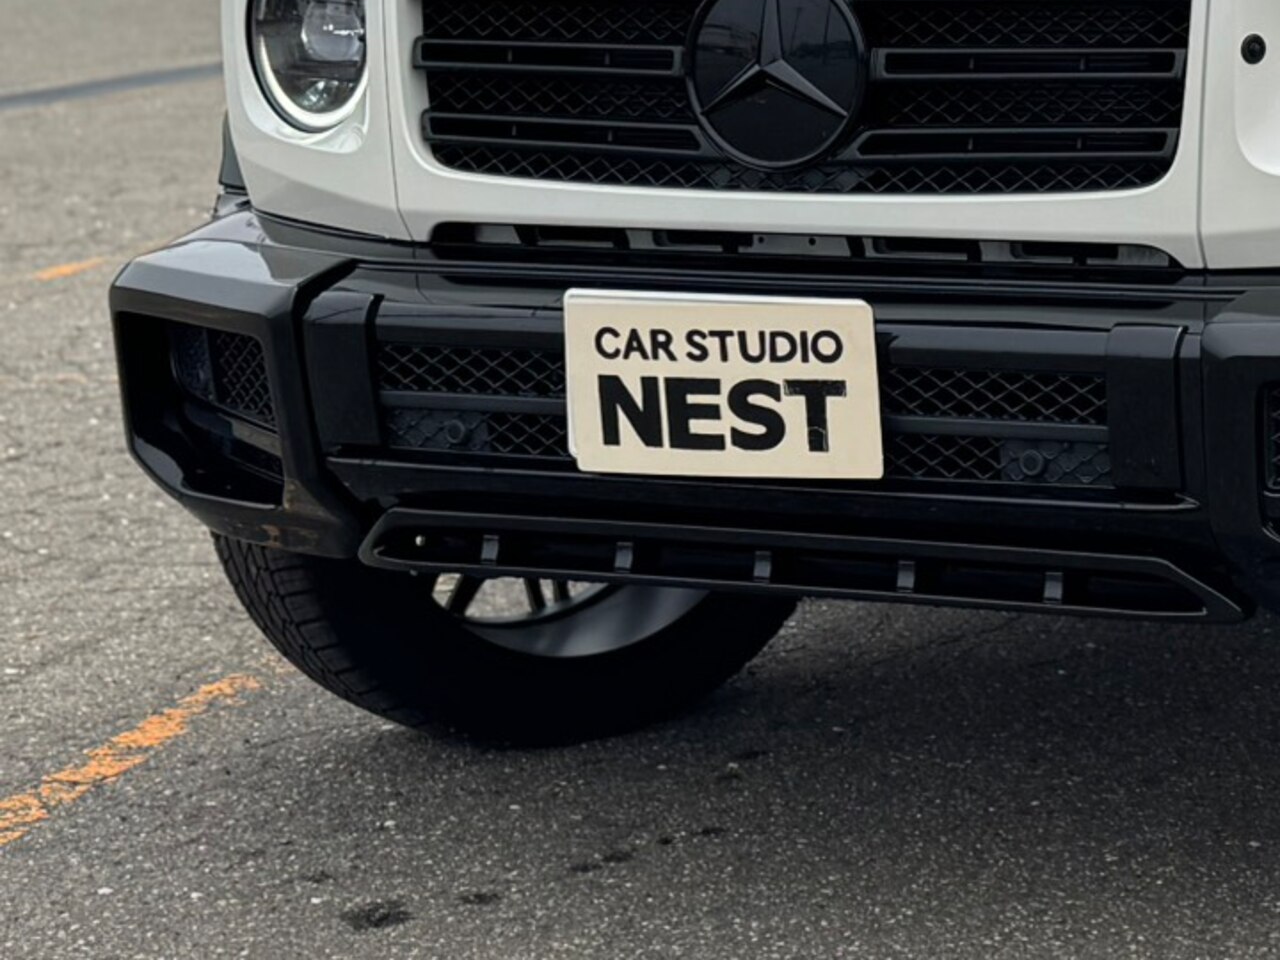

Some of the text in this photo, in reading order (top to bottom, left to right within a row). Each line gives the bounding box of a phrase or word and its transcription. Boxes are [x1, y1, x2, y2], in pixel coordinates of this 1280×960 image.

[594, 326, 844, 364] CAR STUDIO
[597, 374, 848, 453] NEST
